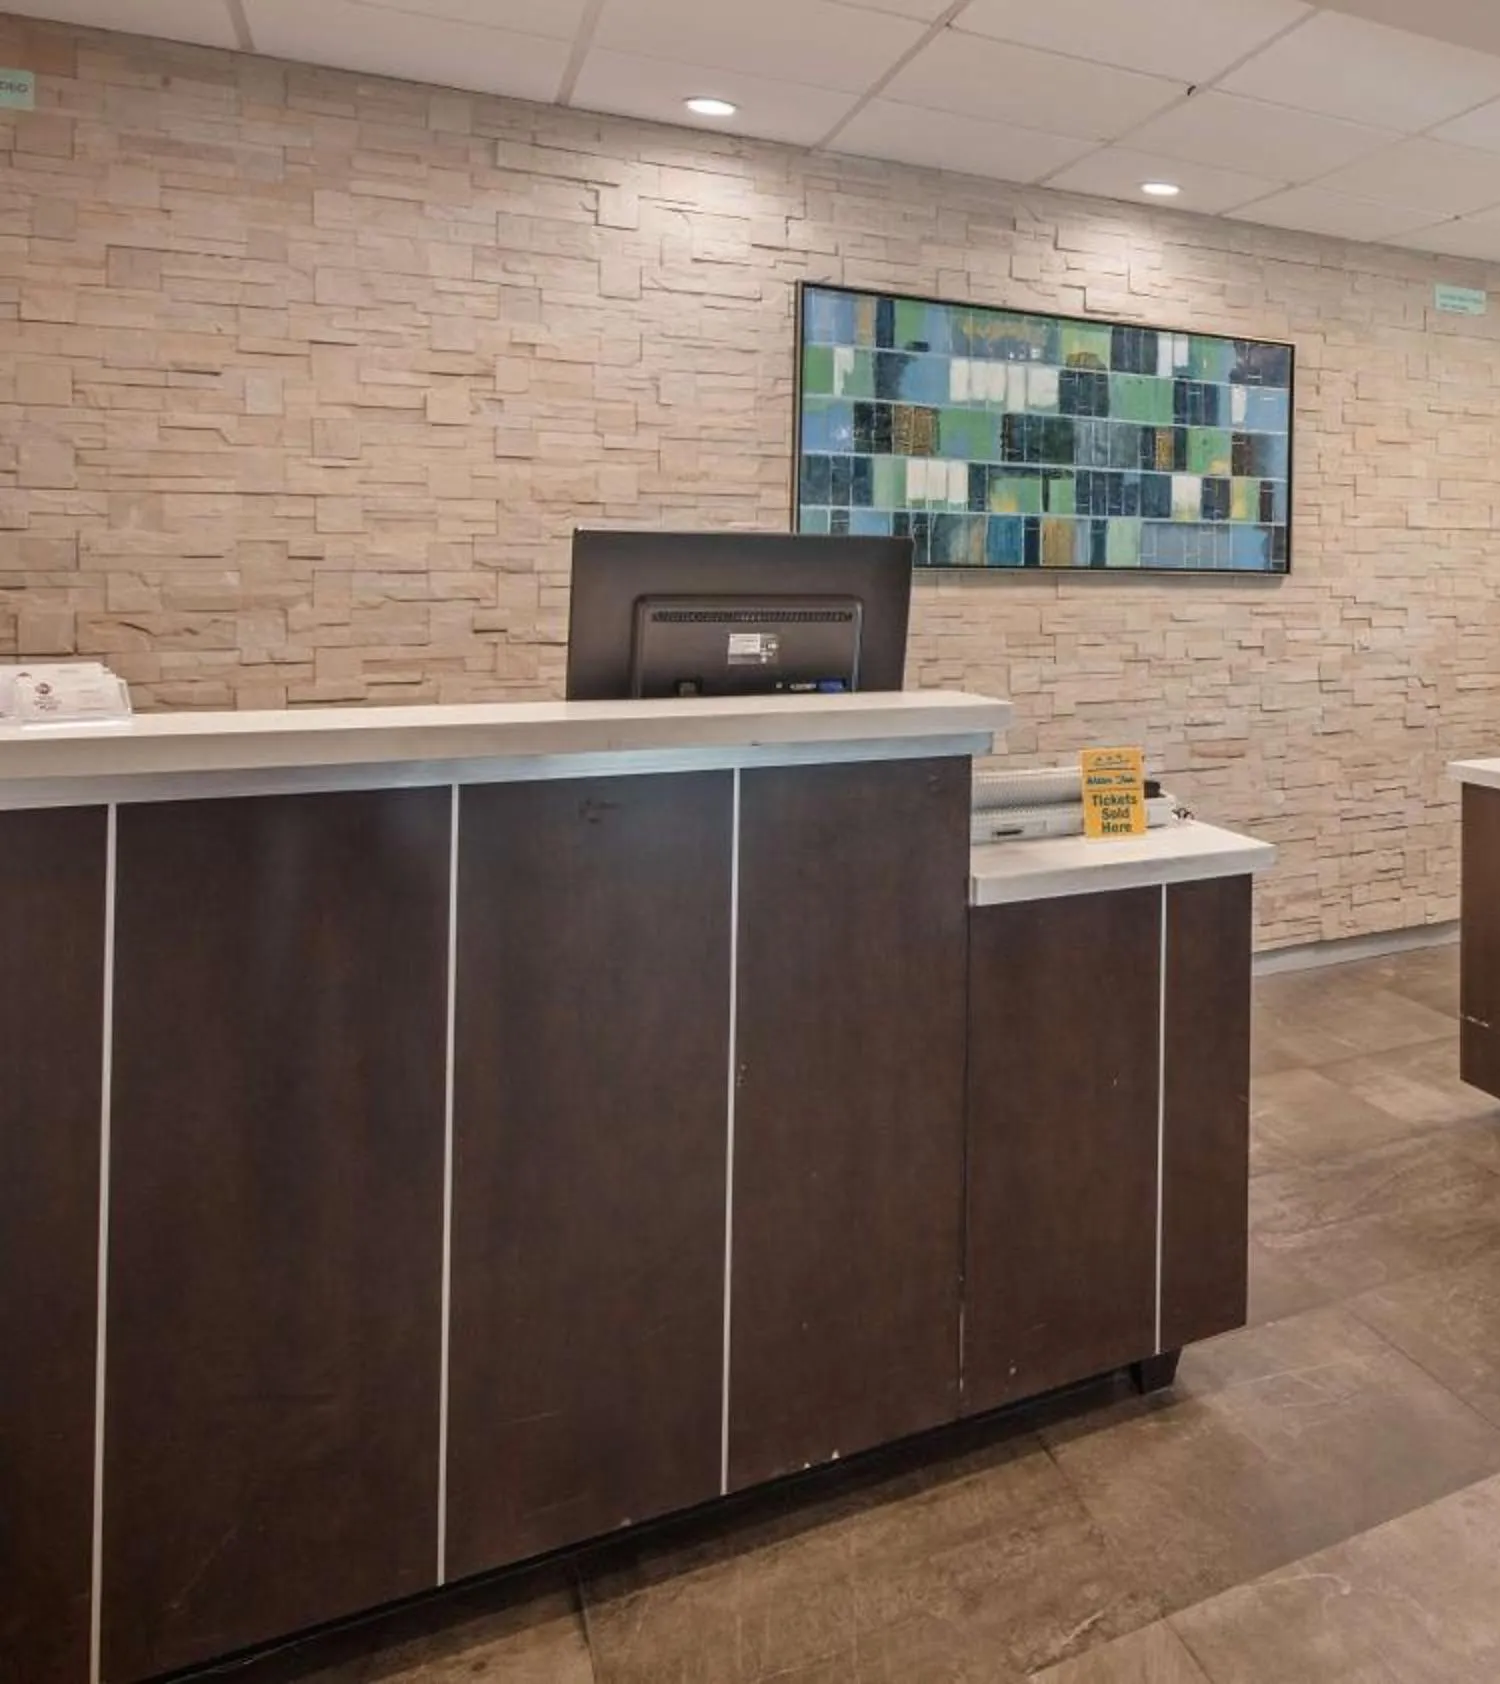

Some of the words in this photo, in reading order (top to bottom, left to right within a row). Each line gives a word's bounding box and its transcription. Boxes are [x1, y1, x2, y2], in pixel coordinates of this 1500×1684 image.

[1092, 793, 1137, 807] Tickets
[1102, 807, 1130, 820] Sold
[1101, 821, 1133, 833] Here
